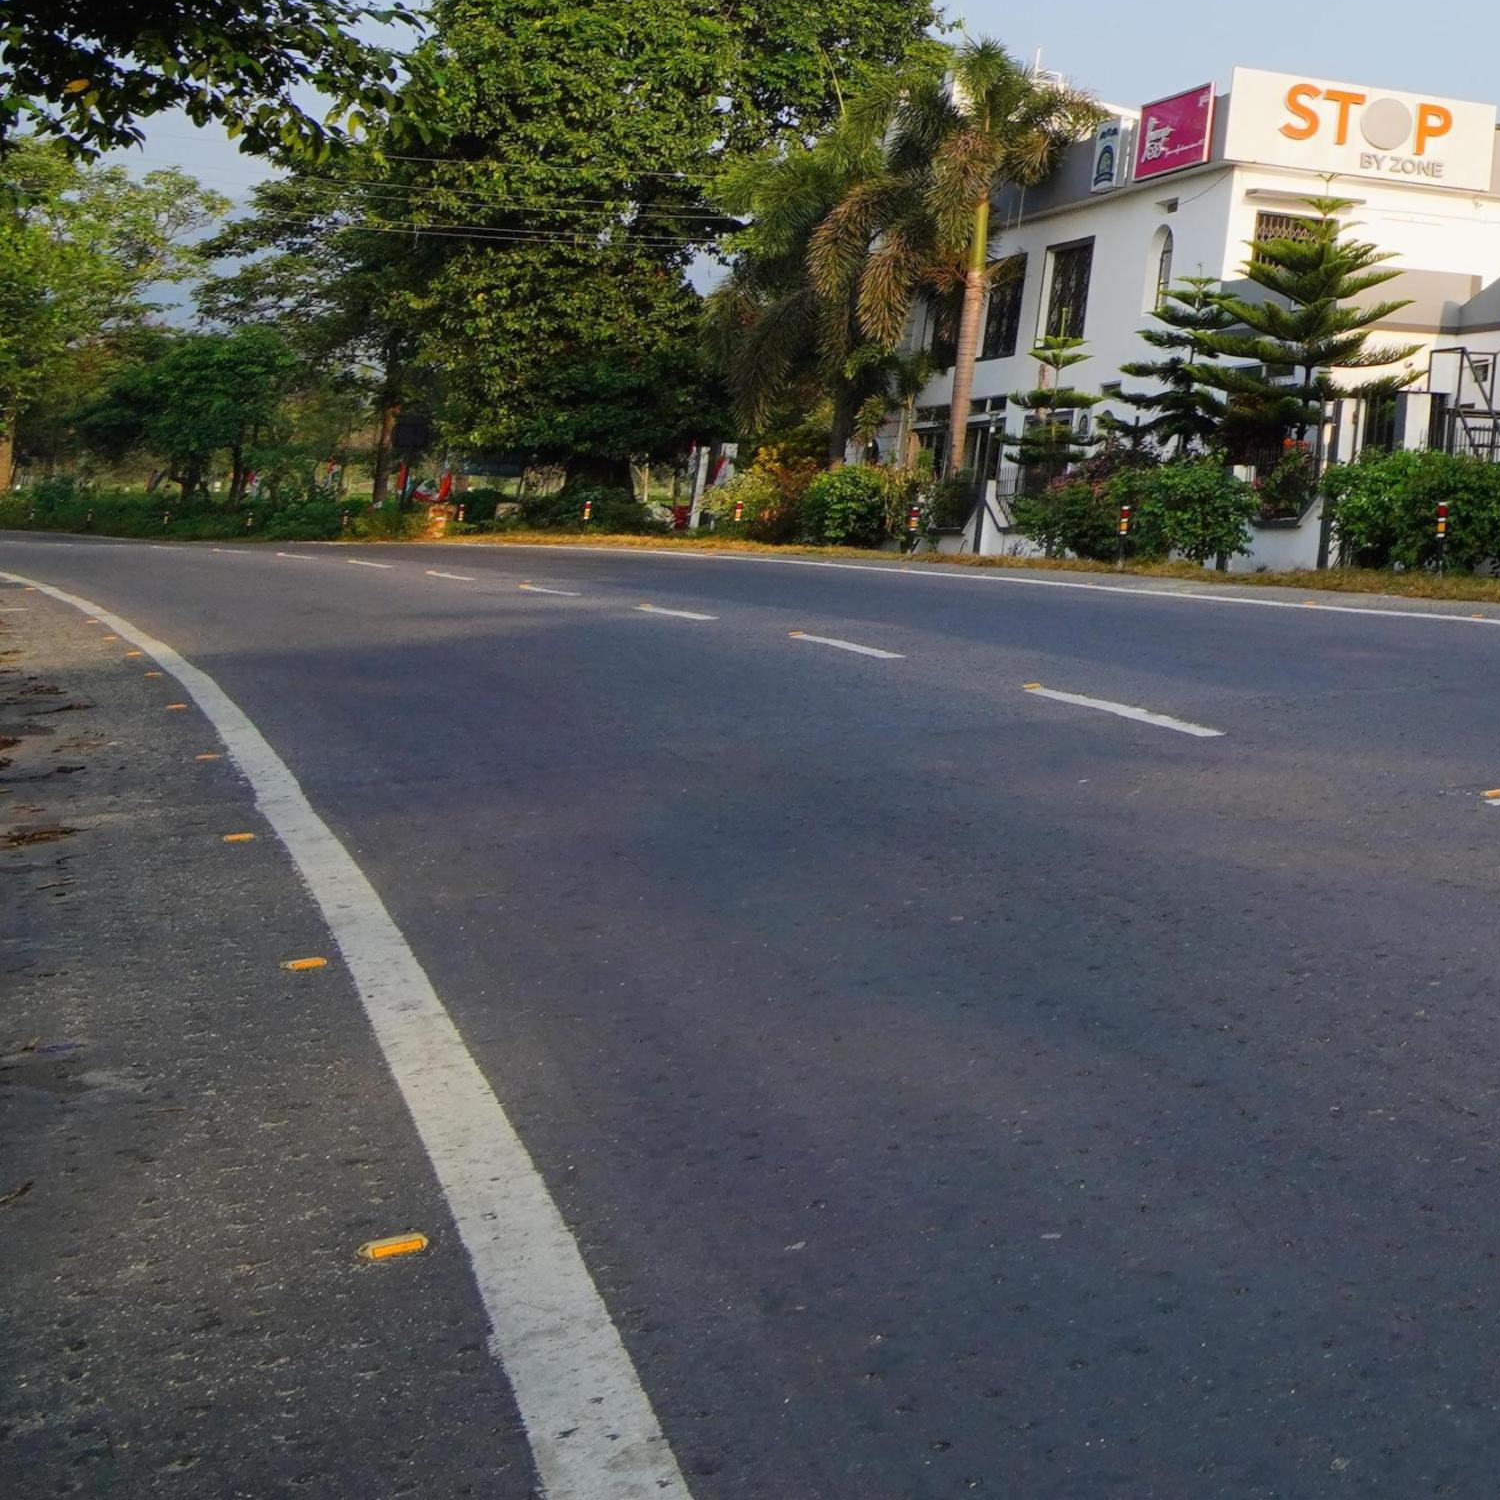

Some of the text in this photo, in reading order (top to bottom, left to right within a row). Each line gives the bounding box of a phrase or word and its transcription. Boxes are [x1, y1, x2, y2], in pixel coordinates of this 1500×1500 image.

[1279, 83, 1453, 156] STOP
[1360, 152, 1444, 179] BY ZONE
